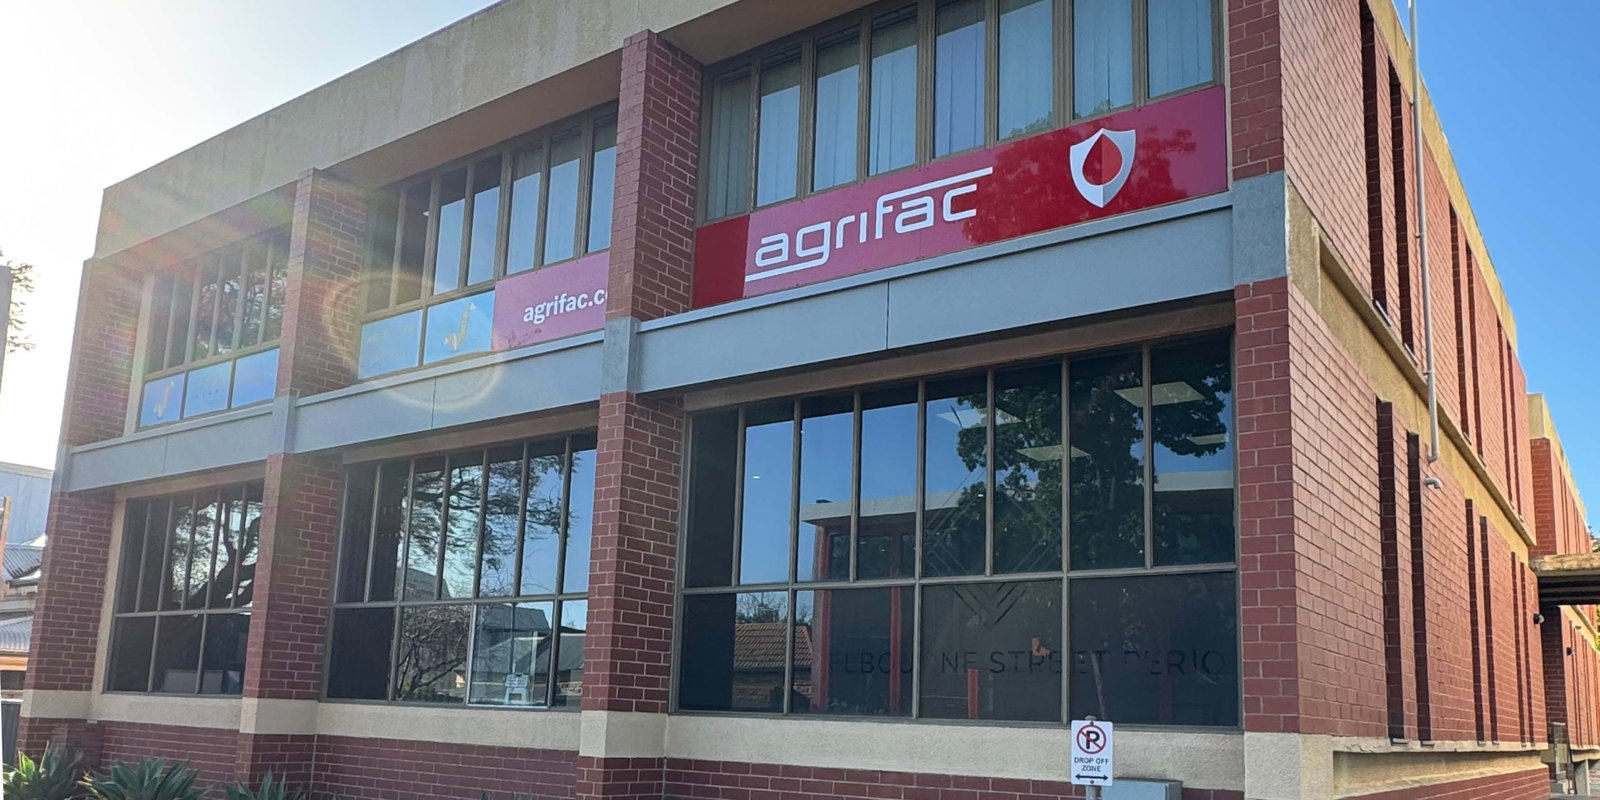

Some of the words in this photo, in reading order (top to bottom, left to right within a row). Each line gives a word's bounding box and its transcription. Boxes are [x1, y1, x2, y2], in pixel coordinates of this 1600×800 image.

[744, 167, 993, 283] agrifac
[523, 288, 608, 325] agrifac.c
[1086, 730, 1100, 749] P
